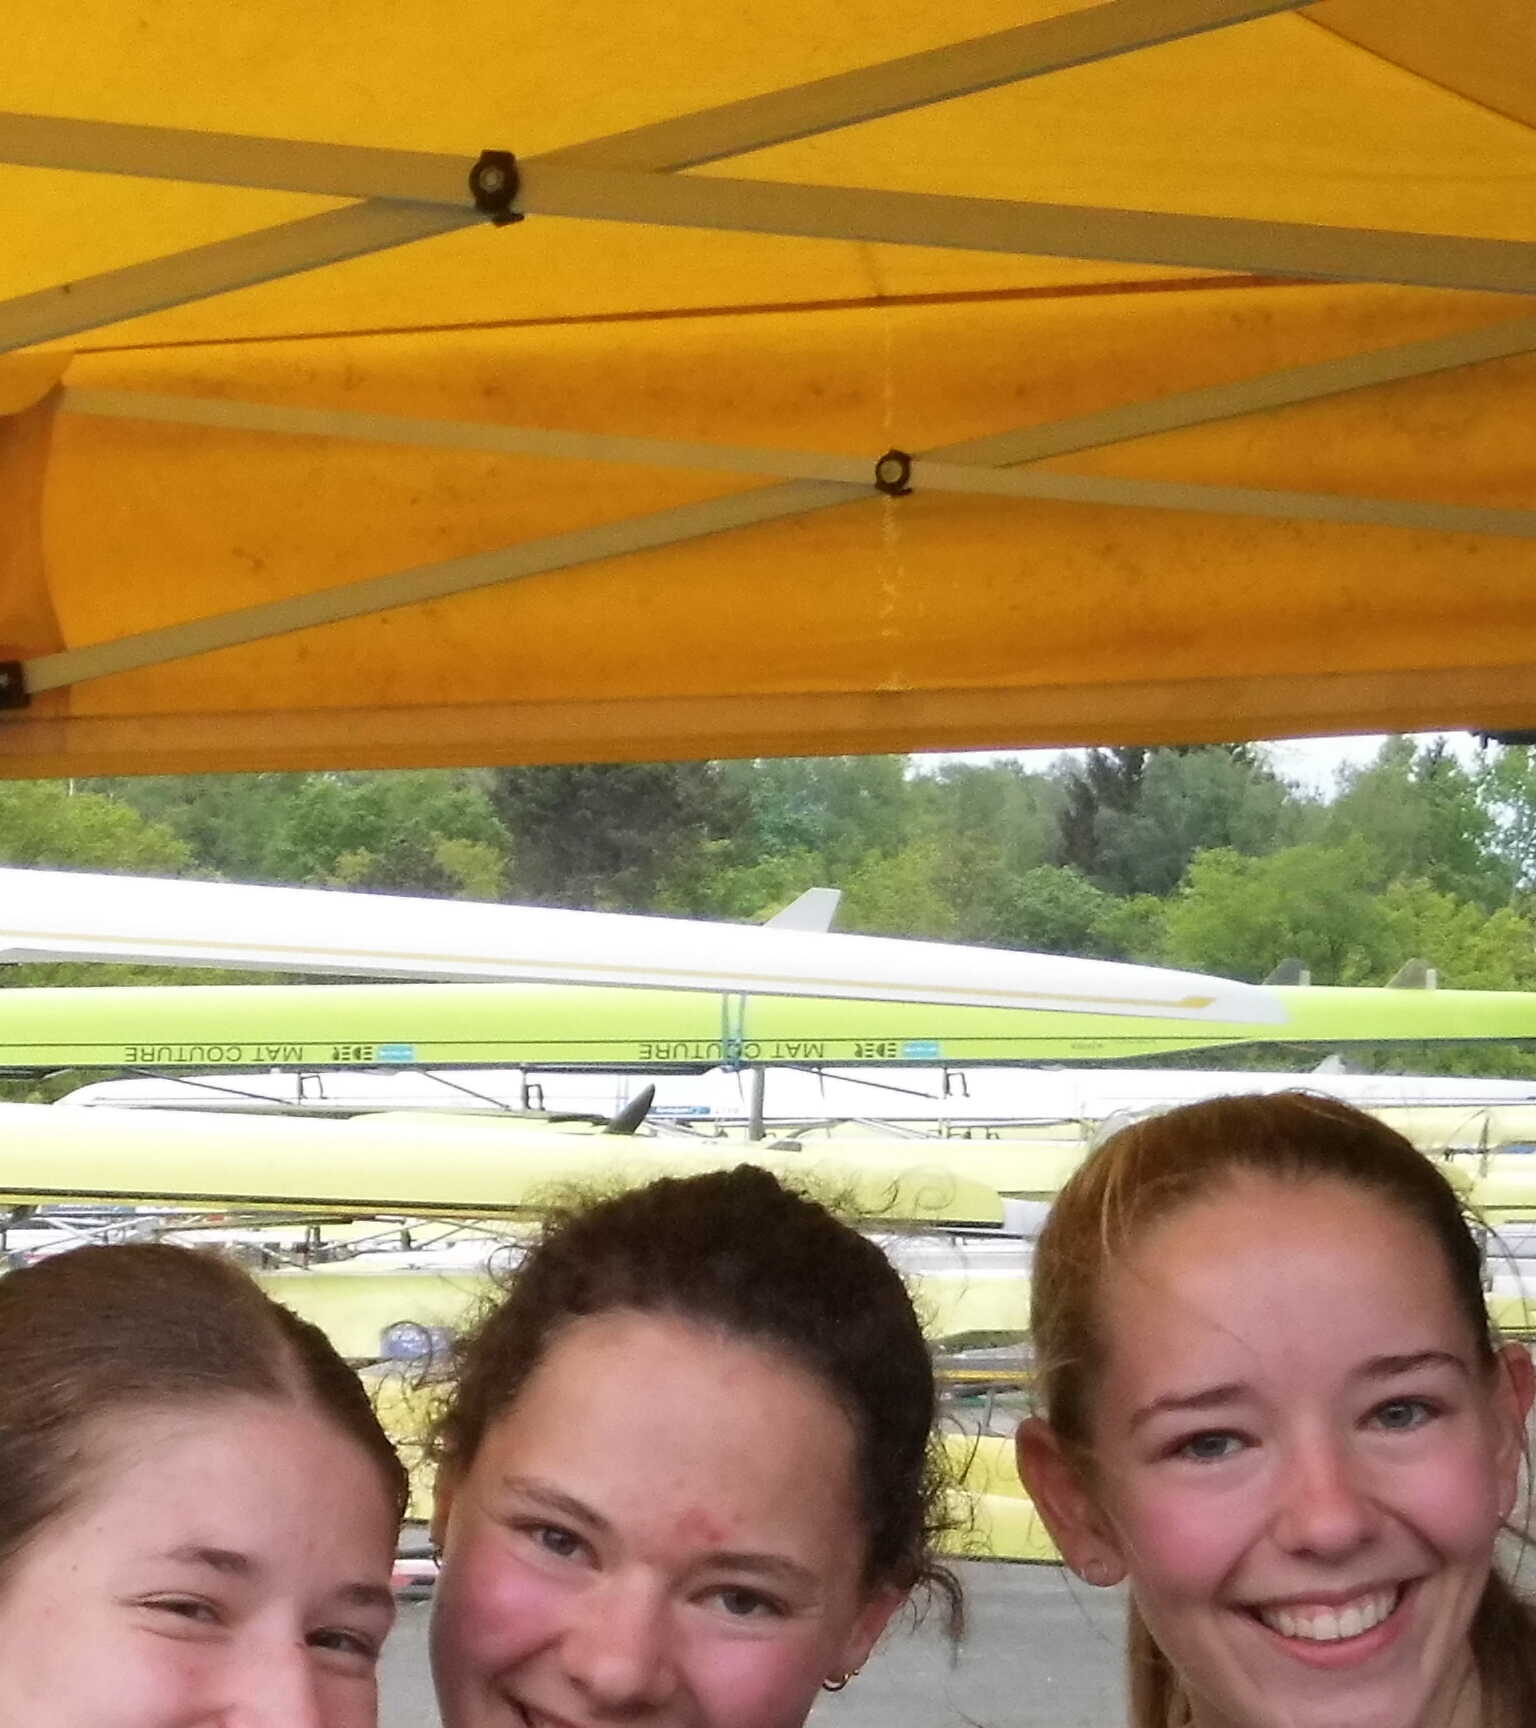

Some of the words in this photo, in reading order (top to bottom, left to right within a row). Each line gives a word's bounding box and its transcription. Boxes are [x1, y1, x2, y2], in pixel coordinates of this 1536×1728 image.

[124, 1046, 242, 1062] COUTURE
[252, 1046, 304, 1061] MAT
[772, 1043, 824, 1059] MAT
